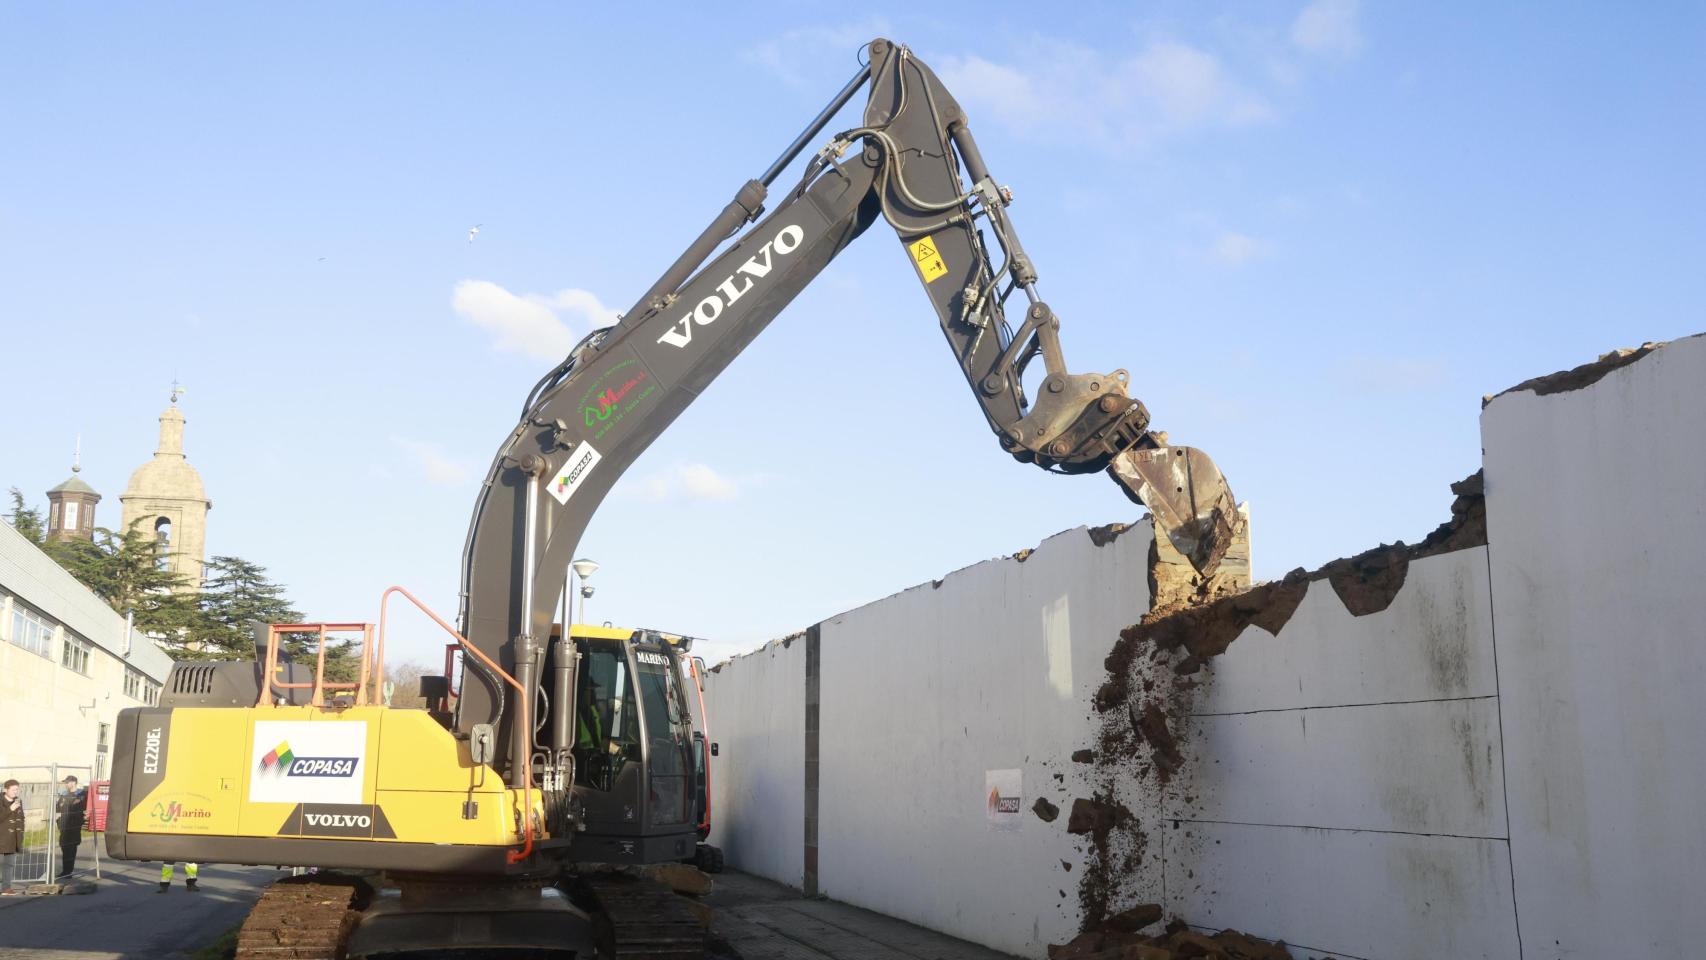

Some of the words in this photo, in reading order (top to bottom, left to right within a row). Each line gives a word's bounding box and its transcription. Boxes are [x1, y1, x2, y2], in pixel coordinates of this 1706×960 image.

[656, 224, 804, 348] VOLVO
[570, 452, 592, 483] COPASA
[292, 759, 353, 775] COPASA
[304, 813, 371, 828] VOLVO
